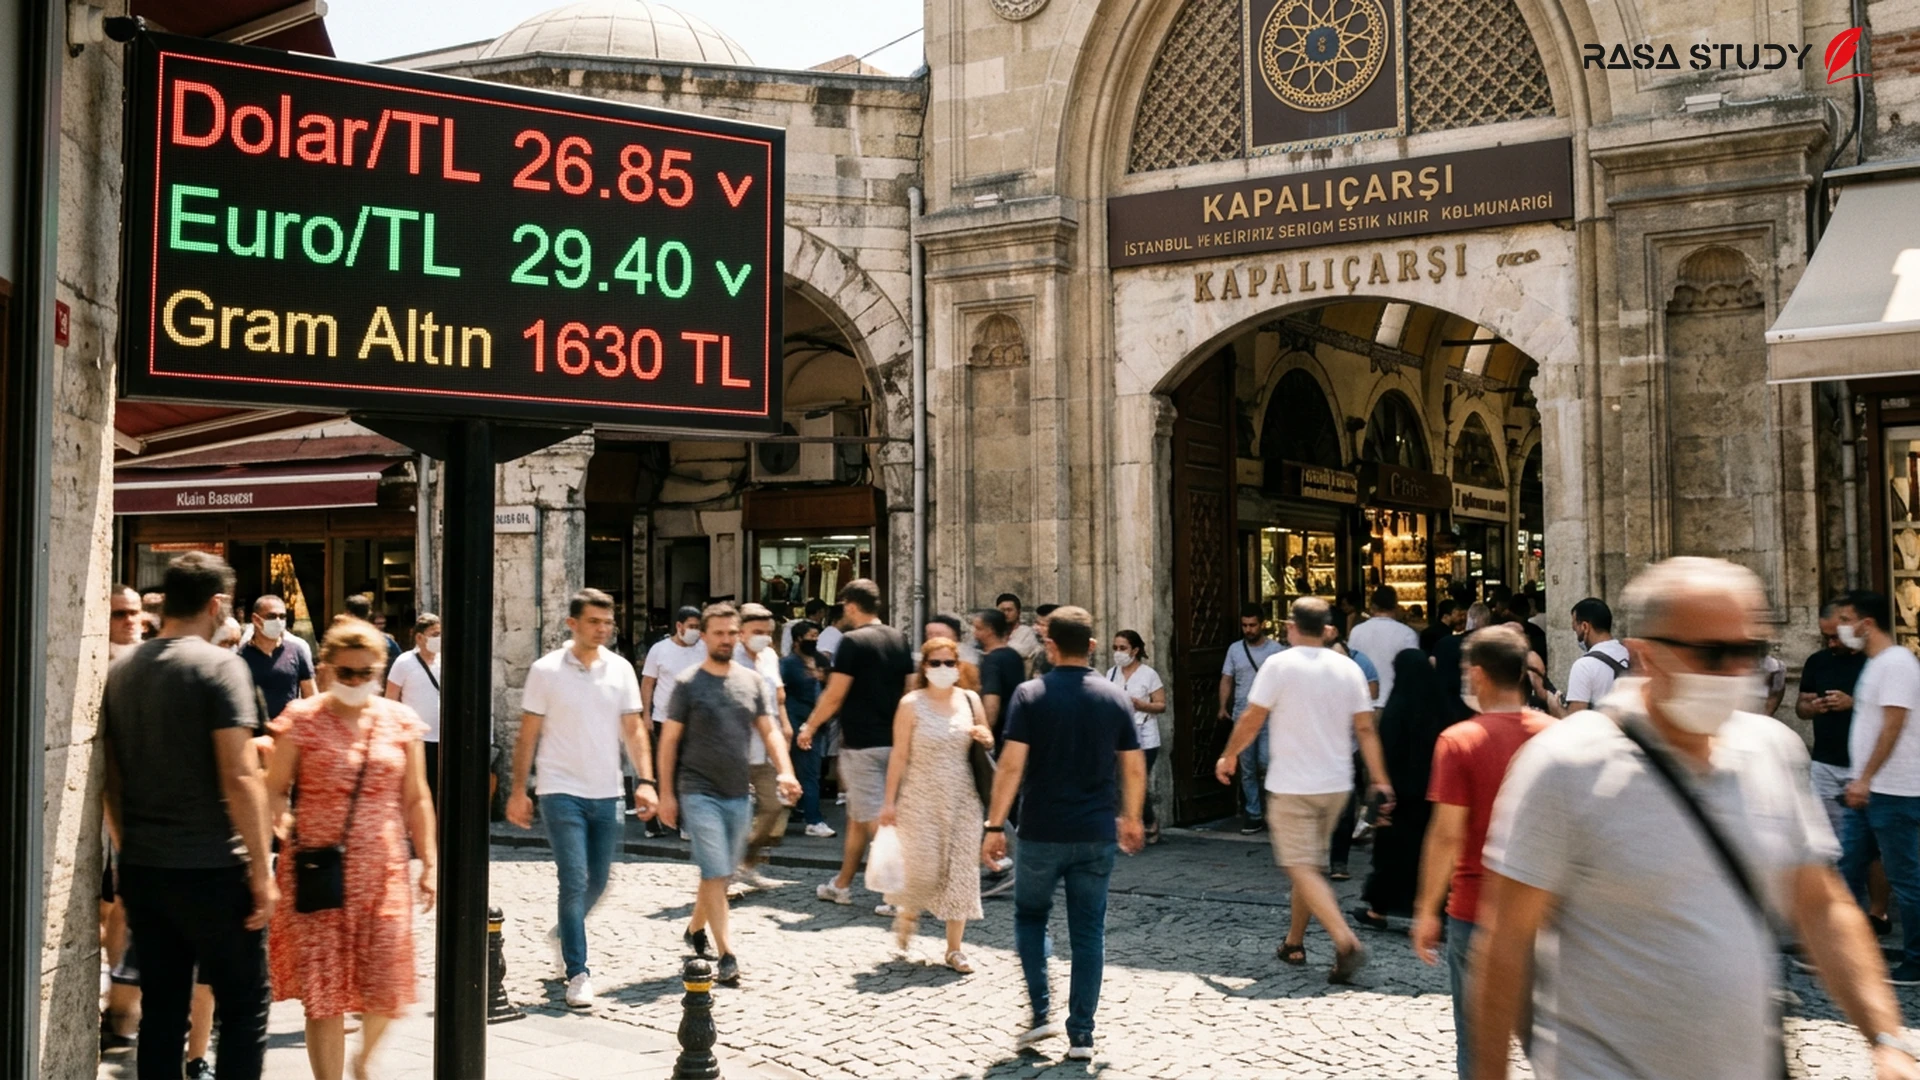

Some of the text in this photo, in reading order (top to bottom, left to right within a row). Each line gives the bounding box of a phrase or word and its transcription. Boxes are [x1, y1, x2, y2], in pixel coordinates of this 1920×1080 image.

[171, 79, 695, 209] Dolar/TL 26.85
[1203, 164, 1453, 224] KAPALIÇARŞI
[170, 183, 694, 299] Euro/TL 29.40
[1124, 236, 1193, 257] İSTANBUL
[1193, 243, 1468, 303] KAPALIÇARŞI
[163, 289, 752, 389] Gram Altın 1630 TL
